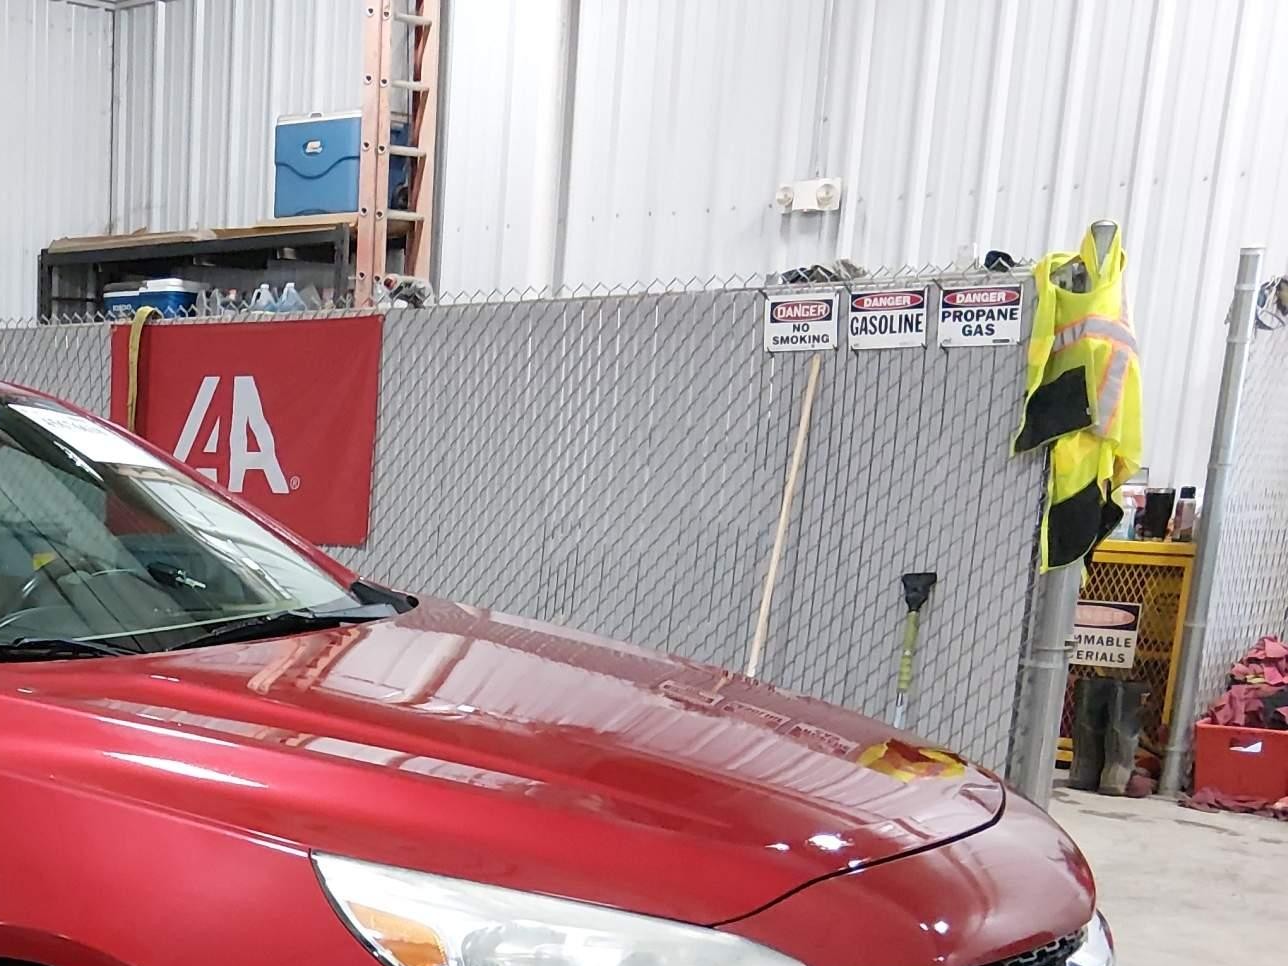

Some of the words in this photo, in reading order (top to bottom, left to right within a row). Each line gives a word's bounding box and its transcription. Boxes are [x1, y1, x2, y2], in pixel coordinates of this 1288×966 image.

[863, 295, 911, 308] DANGER
[955, 291, 1006, 304] DANGER
[776, 304, 826, 318] DANGER
[941, 308, 1019, 323] PROPANE
[792, 323, 810, 333] NO
[850, 313, 924, 336] GASOLINE
[961, 323, 995, 337] GAS
[772, 334, 830, 345] SMOKING
[1074, 634, 1132, 648] MMABLE
[1076, 650, 1126, 664] ERIALS
